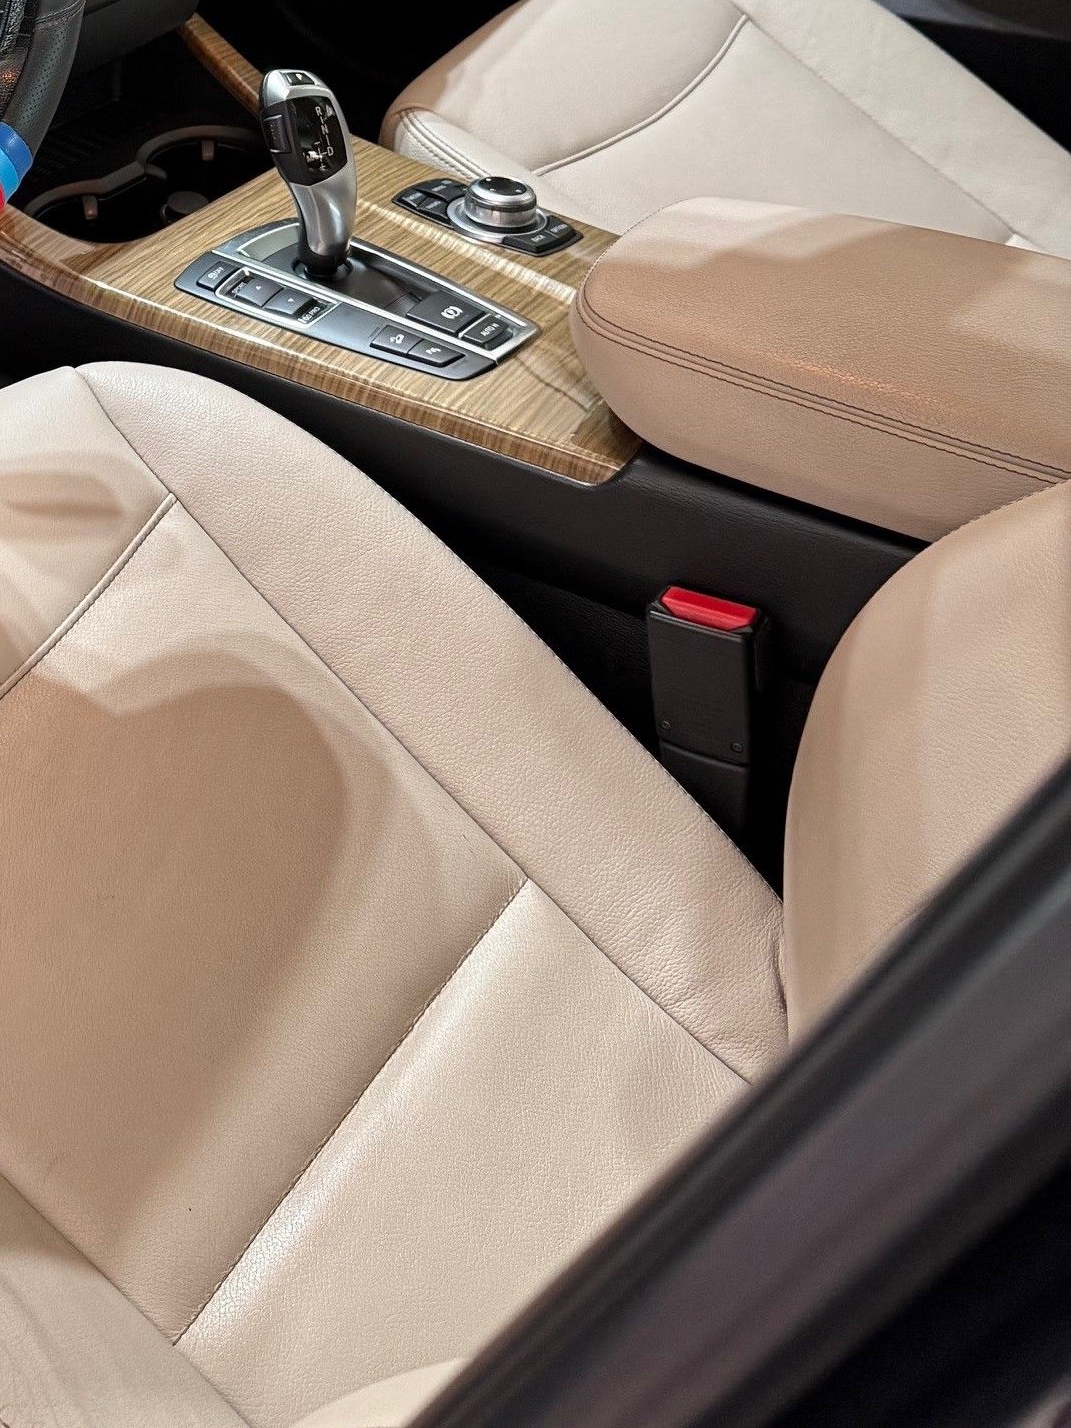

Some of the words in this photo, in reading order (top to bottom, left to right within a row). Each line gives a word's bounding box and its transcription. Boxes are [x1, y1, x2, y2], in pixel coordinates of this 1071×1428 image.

[315, 105, 323, 117] R
[321, 123, 329, 135] N
[326, 146, 334, 157] D
